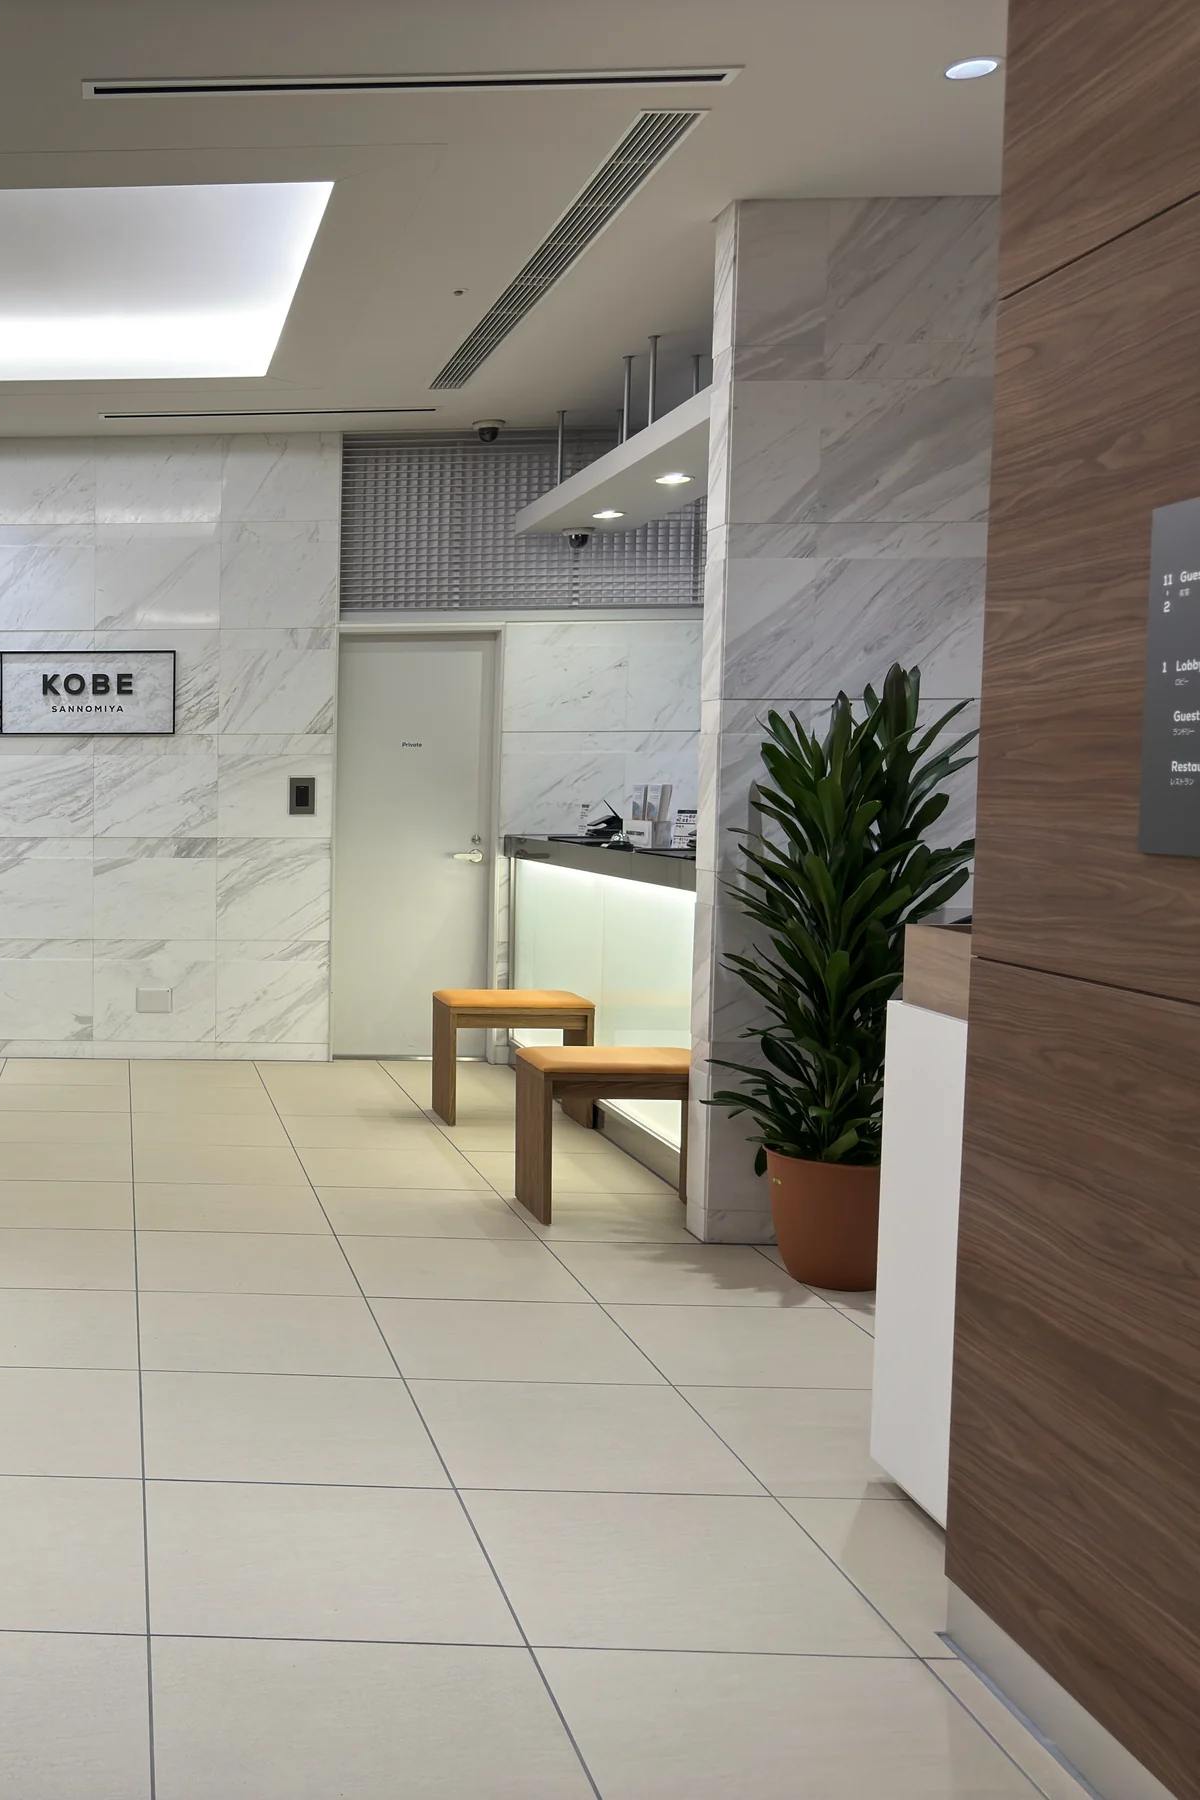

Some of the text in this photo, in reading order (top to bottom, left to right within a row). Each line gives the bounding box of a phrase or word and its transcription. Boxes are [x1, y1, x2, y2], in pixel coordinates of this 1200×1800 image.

[1163, 574, 1173, 586] 11
[1163, 601, 1171, 613] 2
[1162, 661, 1167, 673] 1
[42, 673, 134, 695] KOBE
[51, 705, 124, 713] SANNOMIYA
[1173, 710, 1200, 722] Guest
